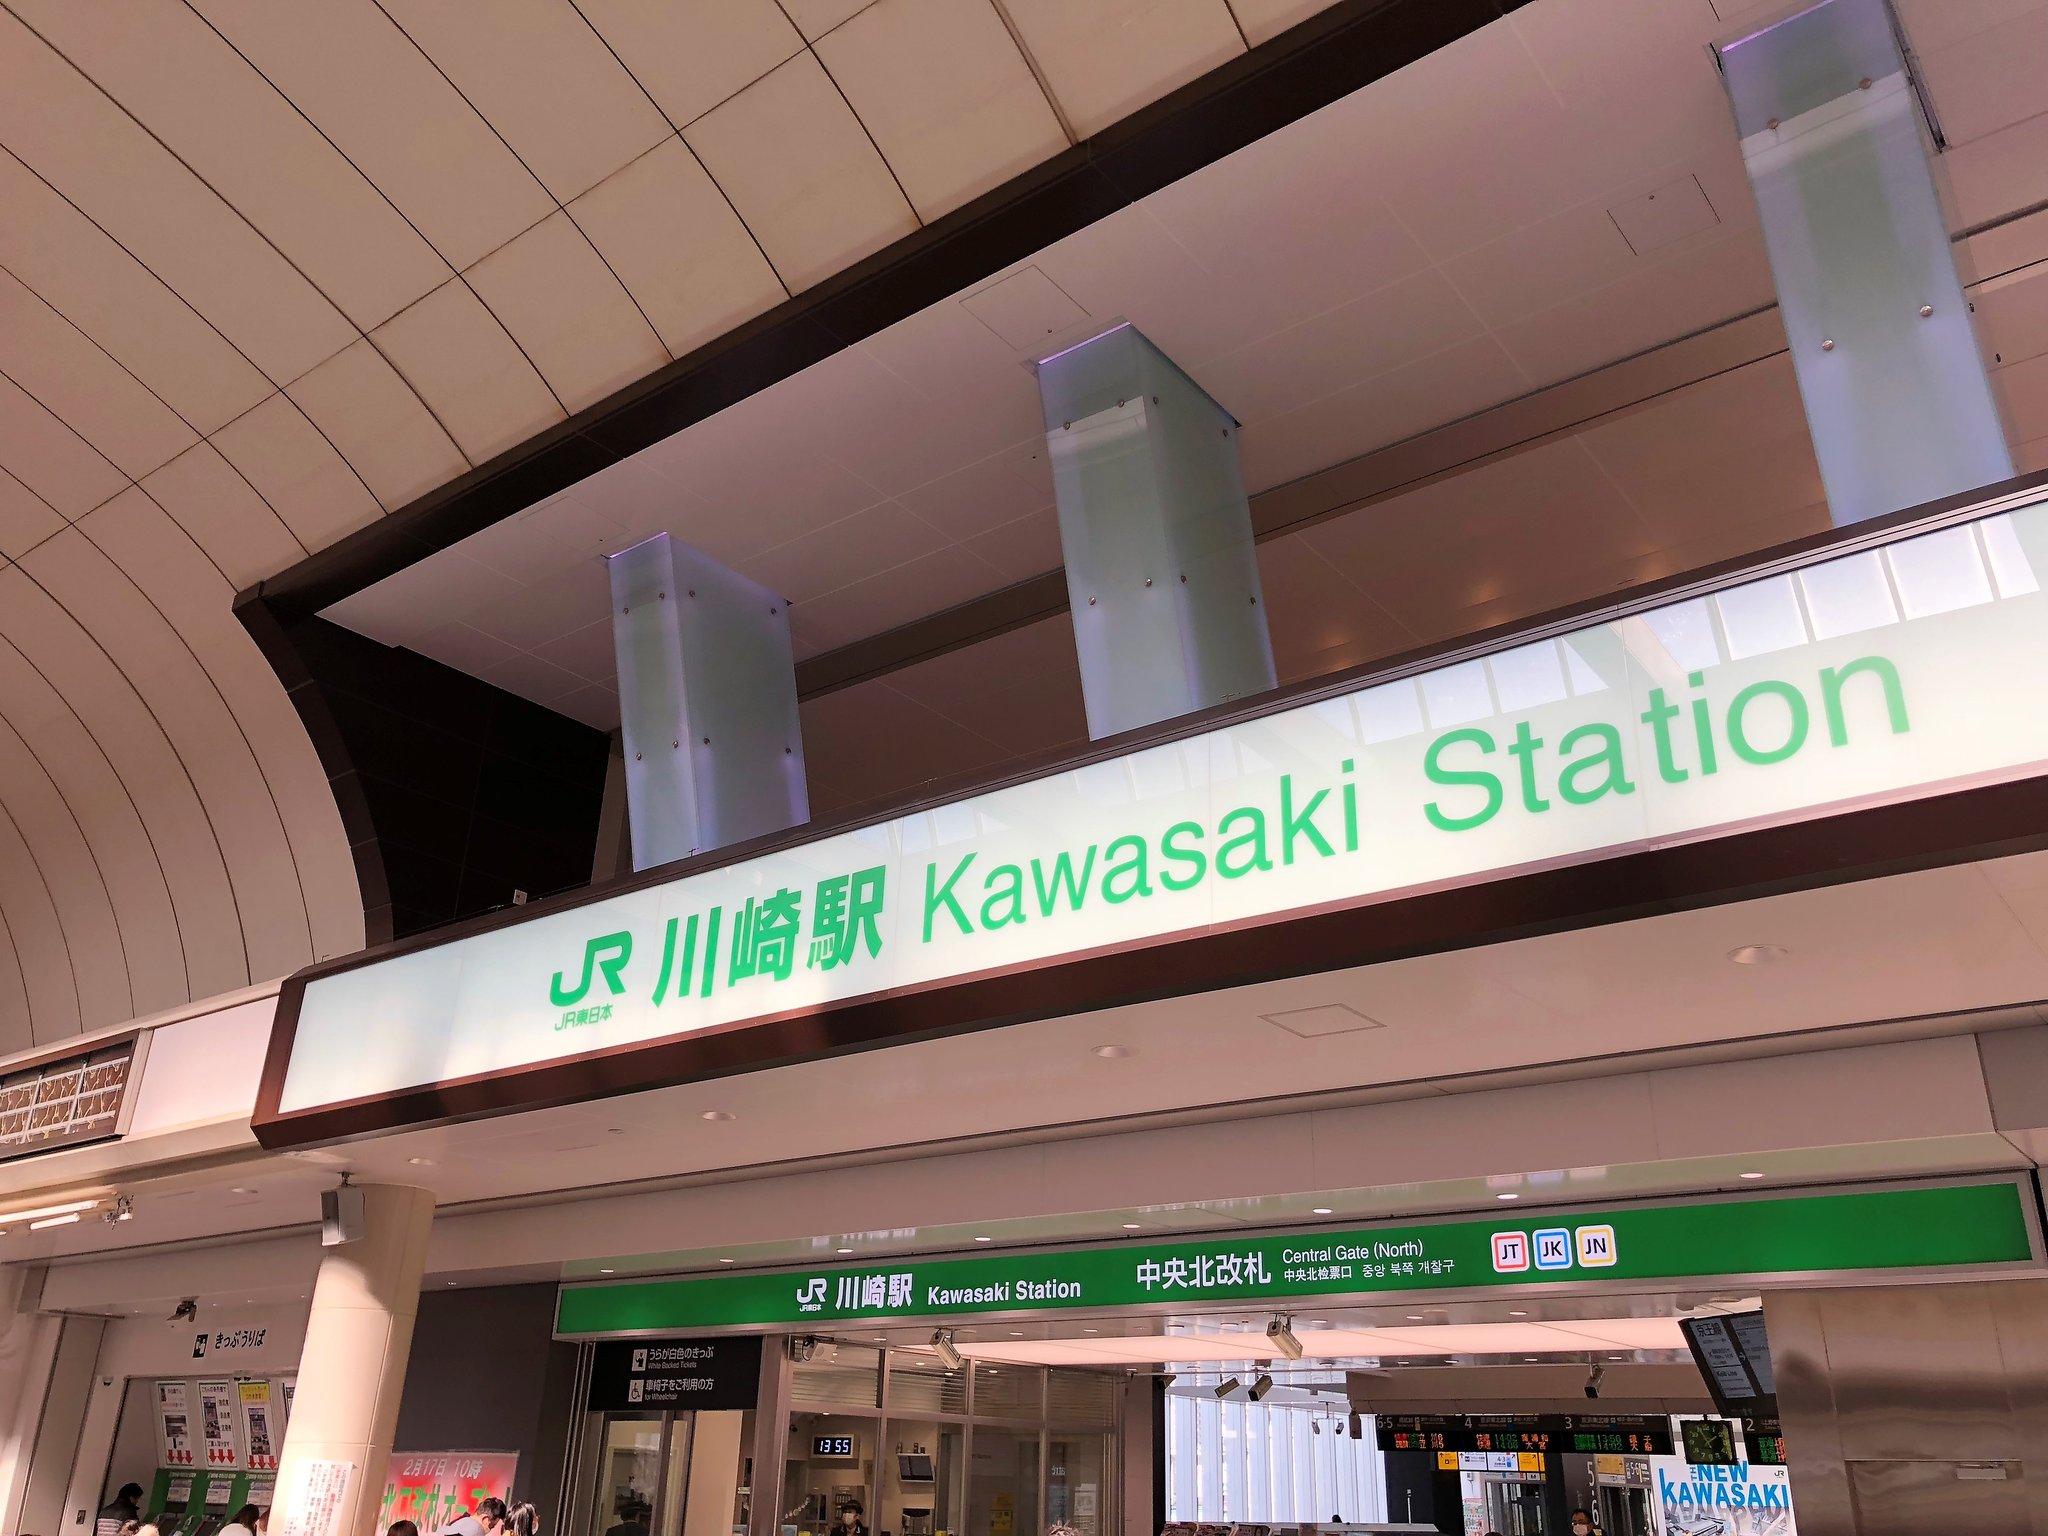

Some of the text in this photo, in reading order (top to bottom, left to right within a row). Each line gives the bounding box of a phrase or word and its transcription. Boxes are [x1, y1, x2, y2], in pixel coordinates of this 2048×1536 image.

[922, 656, 1909, 944] Kawasaki Station
[651, 864, 887, 1008] 川崎駅
[549, 930, 633, 1007] JR
[553, 1003, 613, 1031] JR東日本
[1282, 1238, 1424, 1264] Central Gate (North)
[1502, 1243, 1519, 1260] JT
[1543, 1241, 1562, 1257] JK
[1585, 1238, 1606, 1255] JN
[1136, 1251, 1272, 1291] 中央北改札
[1284, 1265, 1353, 1283] 中央北检票口
[1362, 1259, 1455, 1278] 중앙 북쪽 개찰구
[796, 1278, 827, 1304] JR
[835, 1273, 913, 1310] 川崎駅
[927, 1278, 1081, 1306] Kawasaki Station
[215, 1328, 267, 1350] きっぷうりば
[649, 1346, 715, 1361] うらが白色のきっぷ
[645, 1377, 715, 1391] 車椅子をご利用の方
[1464, 1417, 1473, 1429] 4
[1565, 1416, 1573, 1429] 3
[1745, 1418, 1756, 1432] 2
[402, 1458, 484, 1479] 2月17日 10時
[1697, 1461, 1748, 1483] NEW
